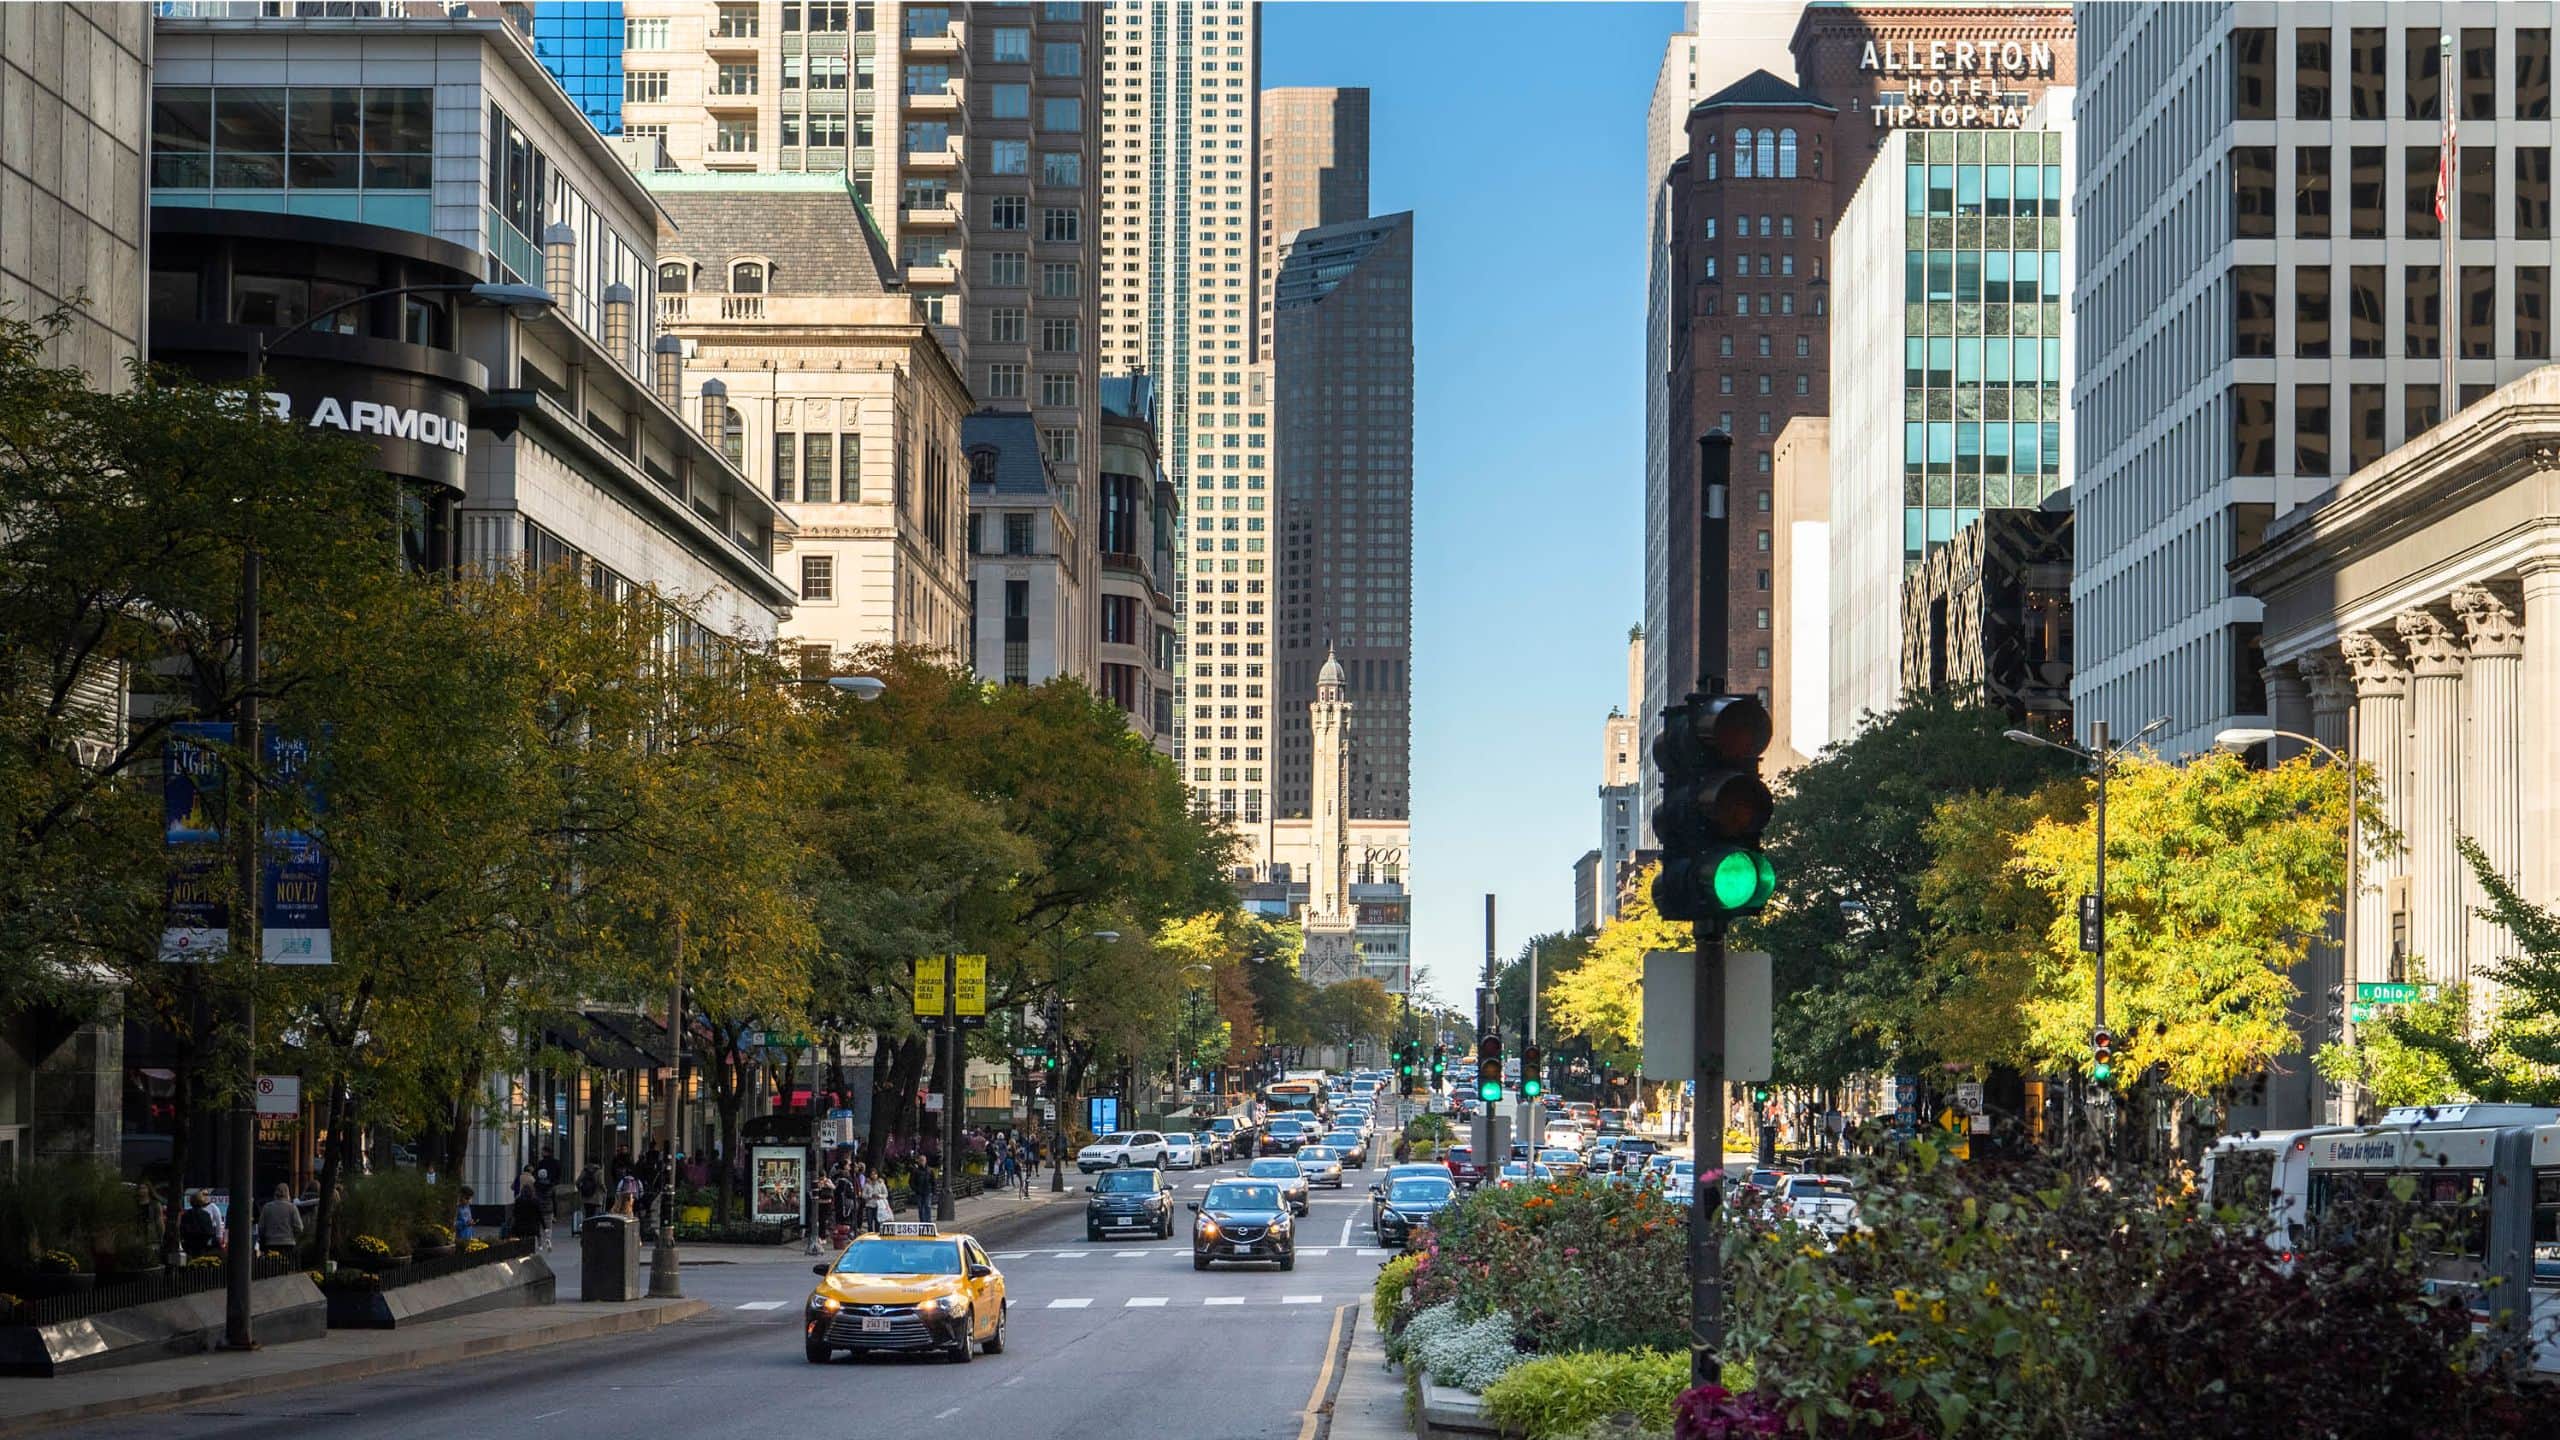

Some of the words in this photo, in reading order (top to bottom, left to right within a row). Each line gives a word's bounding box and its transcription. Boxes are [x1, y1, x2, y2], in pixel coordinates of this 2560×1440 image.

[1859, 40, 2050, 71] ALLERTON
[1908, 79, 2003, 97] HOTEL
[1871, 105, 1915, 127] TIP
[1925, 105, 1978, 127] TOP
[309, 396, 467, 456] ARMOUR
[1365, 847, 1401, 865] 900
[277, 882, 318, 903] NOV.17
[2374, 987, 2403, 999] Ohio
[1899, 1093, 1913, 1101] 90
[1961, 1098, 1978, 1109] 30
[822, 1121, 836, 1129] ONE
[1898, 1114, 1912, 1123] 94
[822, 1129, 836, 1137] WAY
[2338, 1143, 2353, 1160] Clean
[2354, 1142, 2363, 1159] Air
[2364, 1141, 2383, 1163] Hybrid
[2383, 1141, 2394, 1158] Bus
[897, 1224, 917, 1234] 2363
[919, 1224, 935, 1236] TAXI
